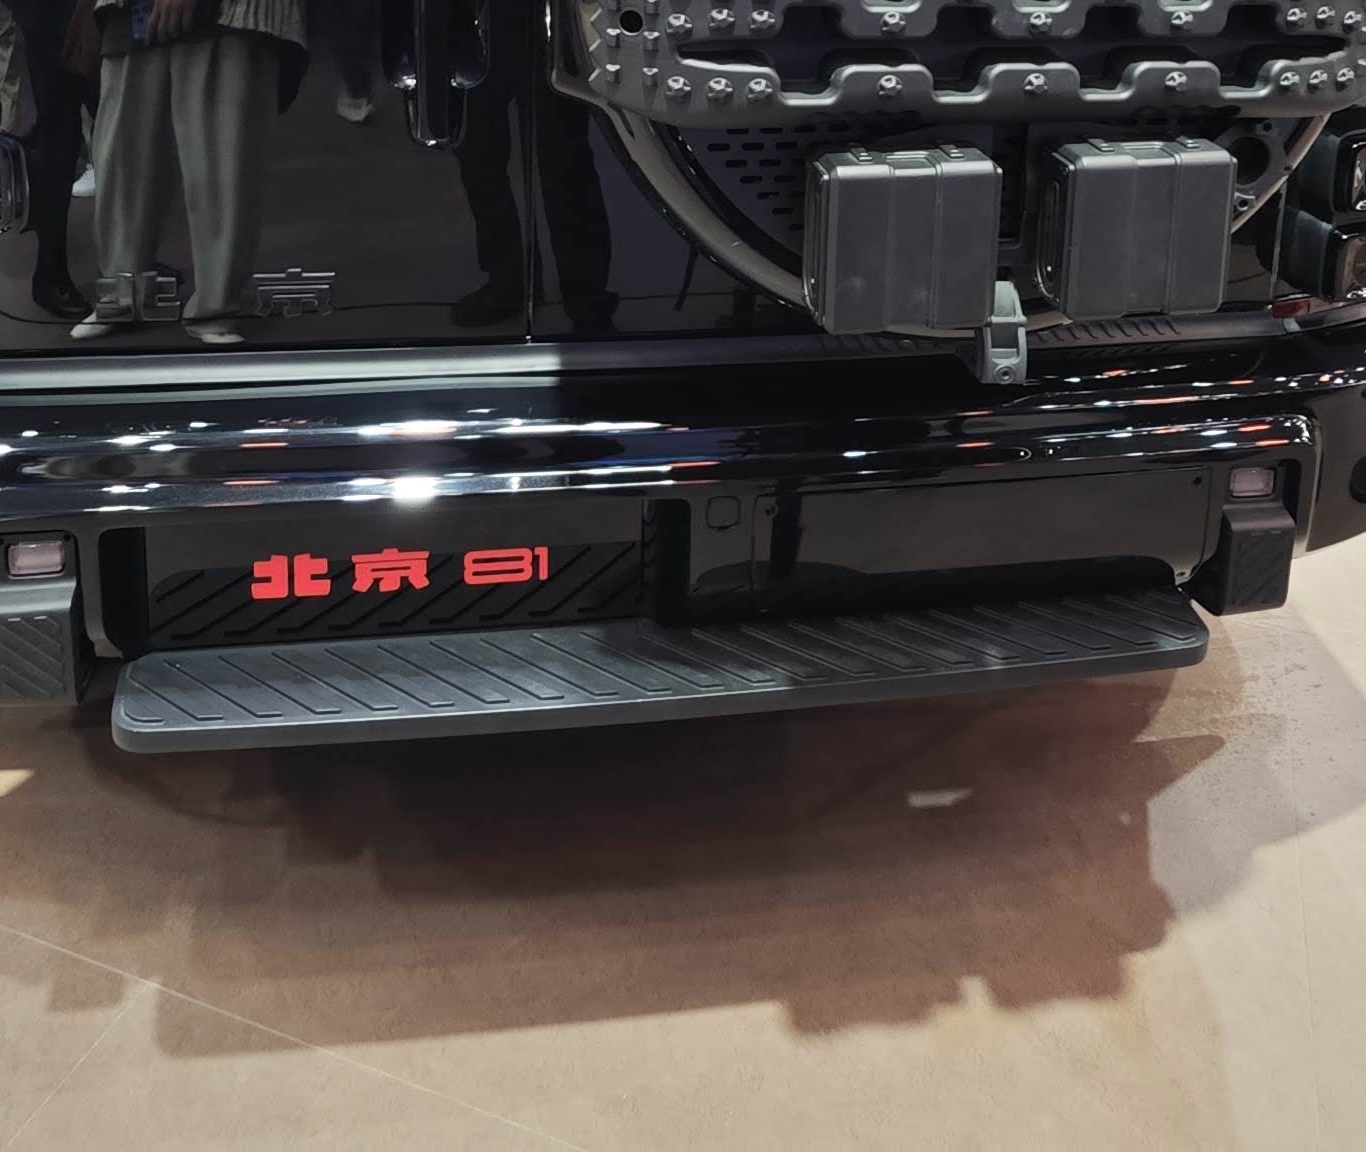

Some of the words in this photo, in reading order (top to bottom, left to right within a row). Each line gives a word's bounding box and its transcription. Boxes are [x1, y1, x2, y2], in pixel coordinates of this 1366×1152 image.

[95, 267, 337, 323] 北京
[251, 548, 430, 600] 北京
[463, 546, 549, 586] 81
